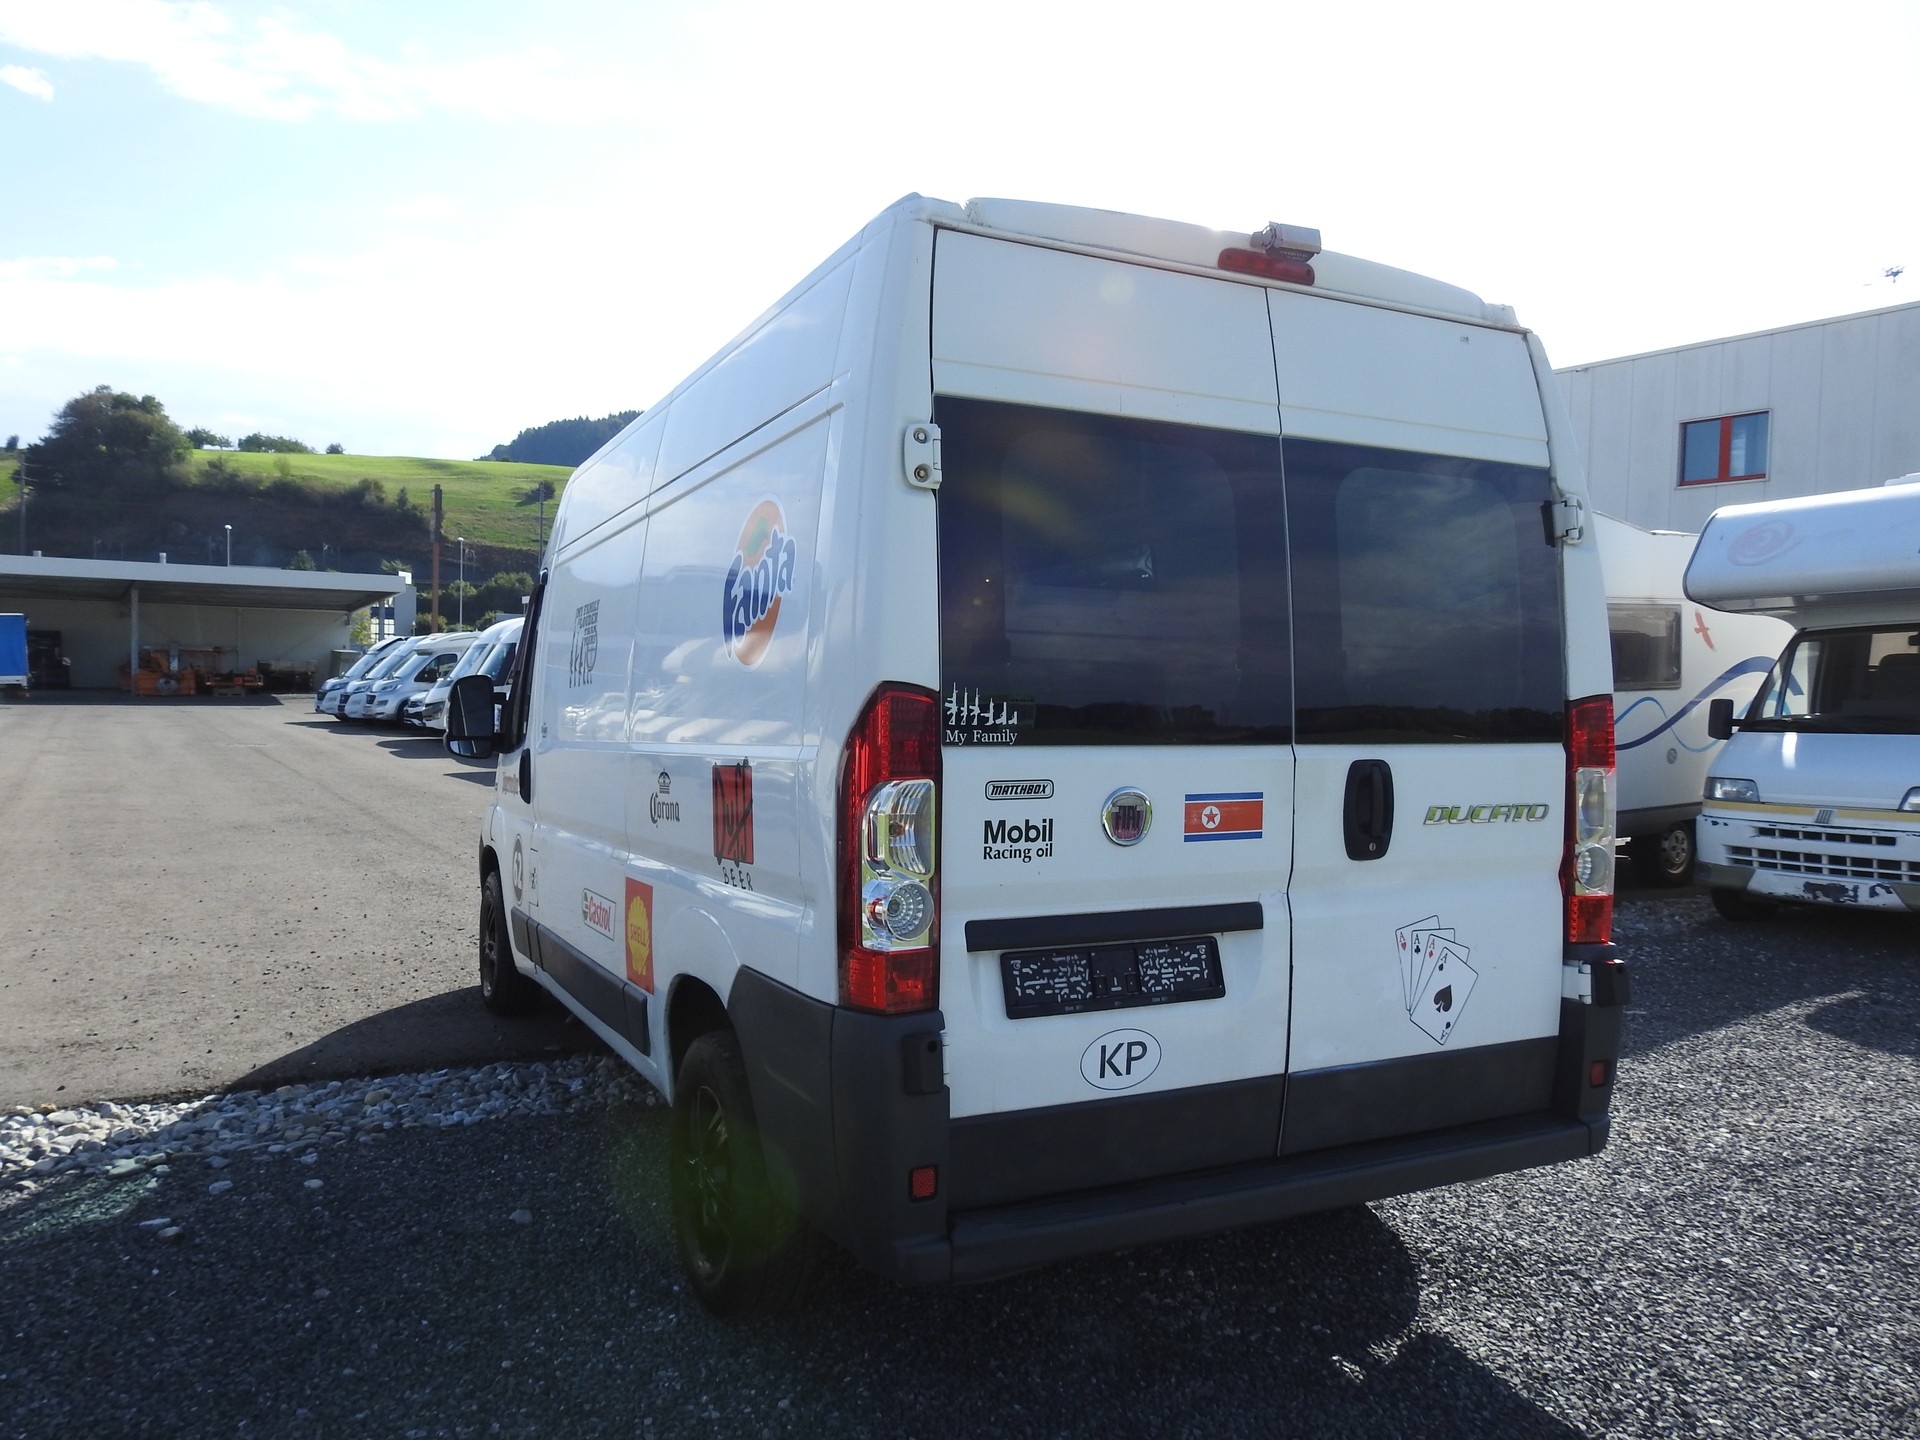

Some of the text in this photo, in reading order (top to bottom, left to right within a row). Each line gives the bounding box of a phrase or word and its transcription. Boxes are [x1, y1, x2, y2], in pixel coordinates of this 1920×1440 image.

[722, 528, 797, 659] Fanta
[945, 729, 1018, 745] My Family
[990, 784, 1049, 796] MATCHBOX
[650, 792, 680, 825] Corona
[1423, 803, 1550, 826] DUCATO
[983, 818, 1054, 844] Mobil
[983, 843, 1053, 863] Racing oil
[722, 867, 753, 891] BEER
[588, 895, 611, 933] Castrol
[630, 923, 647, 947] SHELL
[1399, 931, 1406, 942] A
[1414, 933, 1420, 945] A
[1429, 938, 1435, 949] A
[1440, 952, 1448, 963] A
[1099, 1040, 1148, 1079] KP
